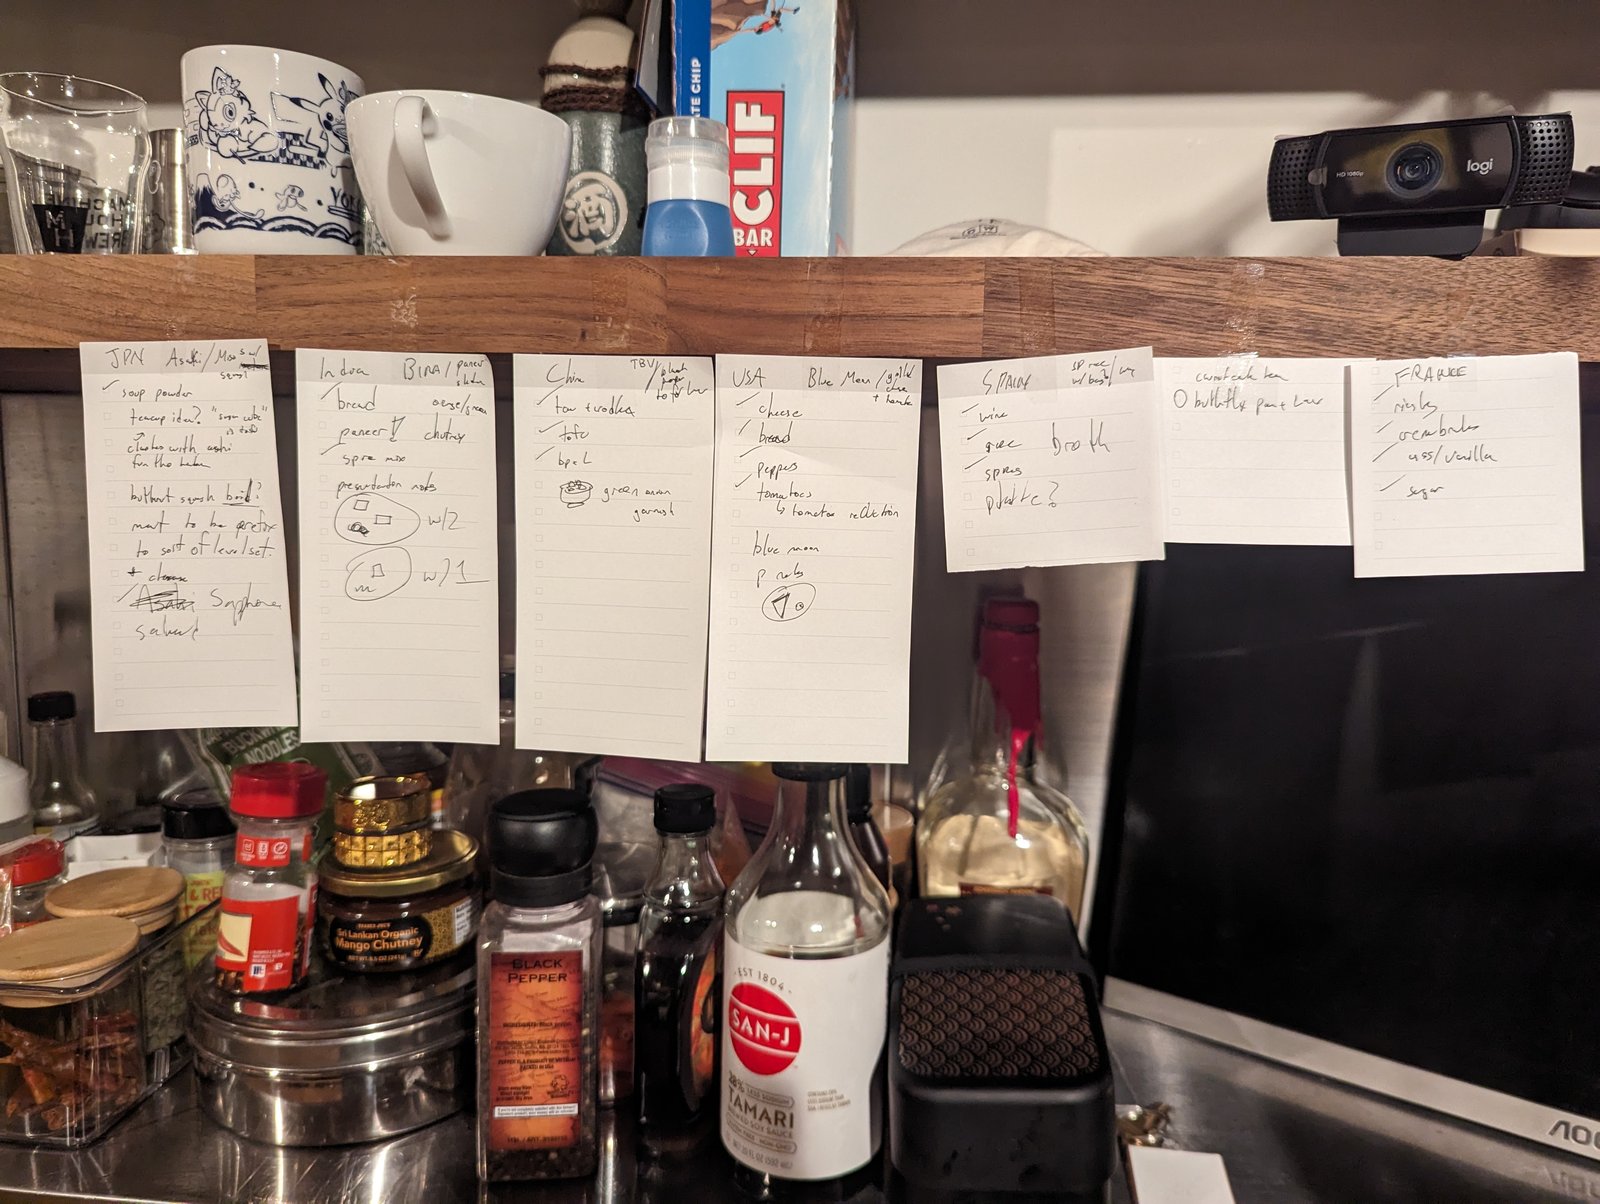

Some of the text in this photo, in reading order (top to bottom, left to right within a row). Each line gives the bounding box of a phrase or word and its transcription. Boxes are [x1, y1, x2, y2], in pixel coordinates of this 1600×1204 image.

[690, 57, 701, 94] CHIP
[733, 102, 776, 225] CLIF
[1466, 158, 1494, 175] logi
[734, 229, 773, 247] BAR
[105, 347, 145, 369] JPN
[732, 367, 766, 388] USA
[807, 367, 834, 388] Blue
[982, 369, 1032, 395] SPAIN
[1395, 363, 1467, 388] FRANCE
[122, 384, 193, 402] soup powder
[337, 385, 377, 411] bread
[759, 392, 803, 418] cheese
[169, 434, 196, 454] with
[1052, 418, 1110, 456] broth
[602, 485, 639, 503] green
[185, 512, 196, 529] to
[137, 539, 149, 557] to
[161, 534, 186, 555] sort
[190, 530, 210, 556] of
[753, 530, 779, 557] blue
[244, 730, 301, 764] NOODLES
[348, 930, 379, 939] Lankan
[381, 926, 419, 939] Organic
[335, 936, 424, 952] Mango Chutney
[512, 958, 562, 970] BLACK
[508, 973, 567, 983] PEPPER
[737, 967, 785, 990] EST 1804
[731, 1007, 791, 1047] SAN-J
[729, 1085, 794, 1128] TAMARI
[766, 1126, 793, 1139] SAUCE
